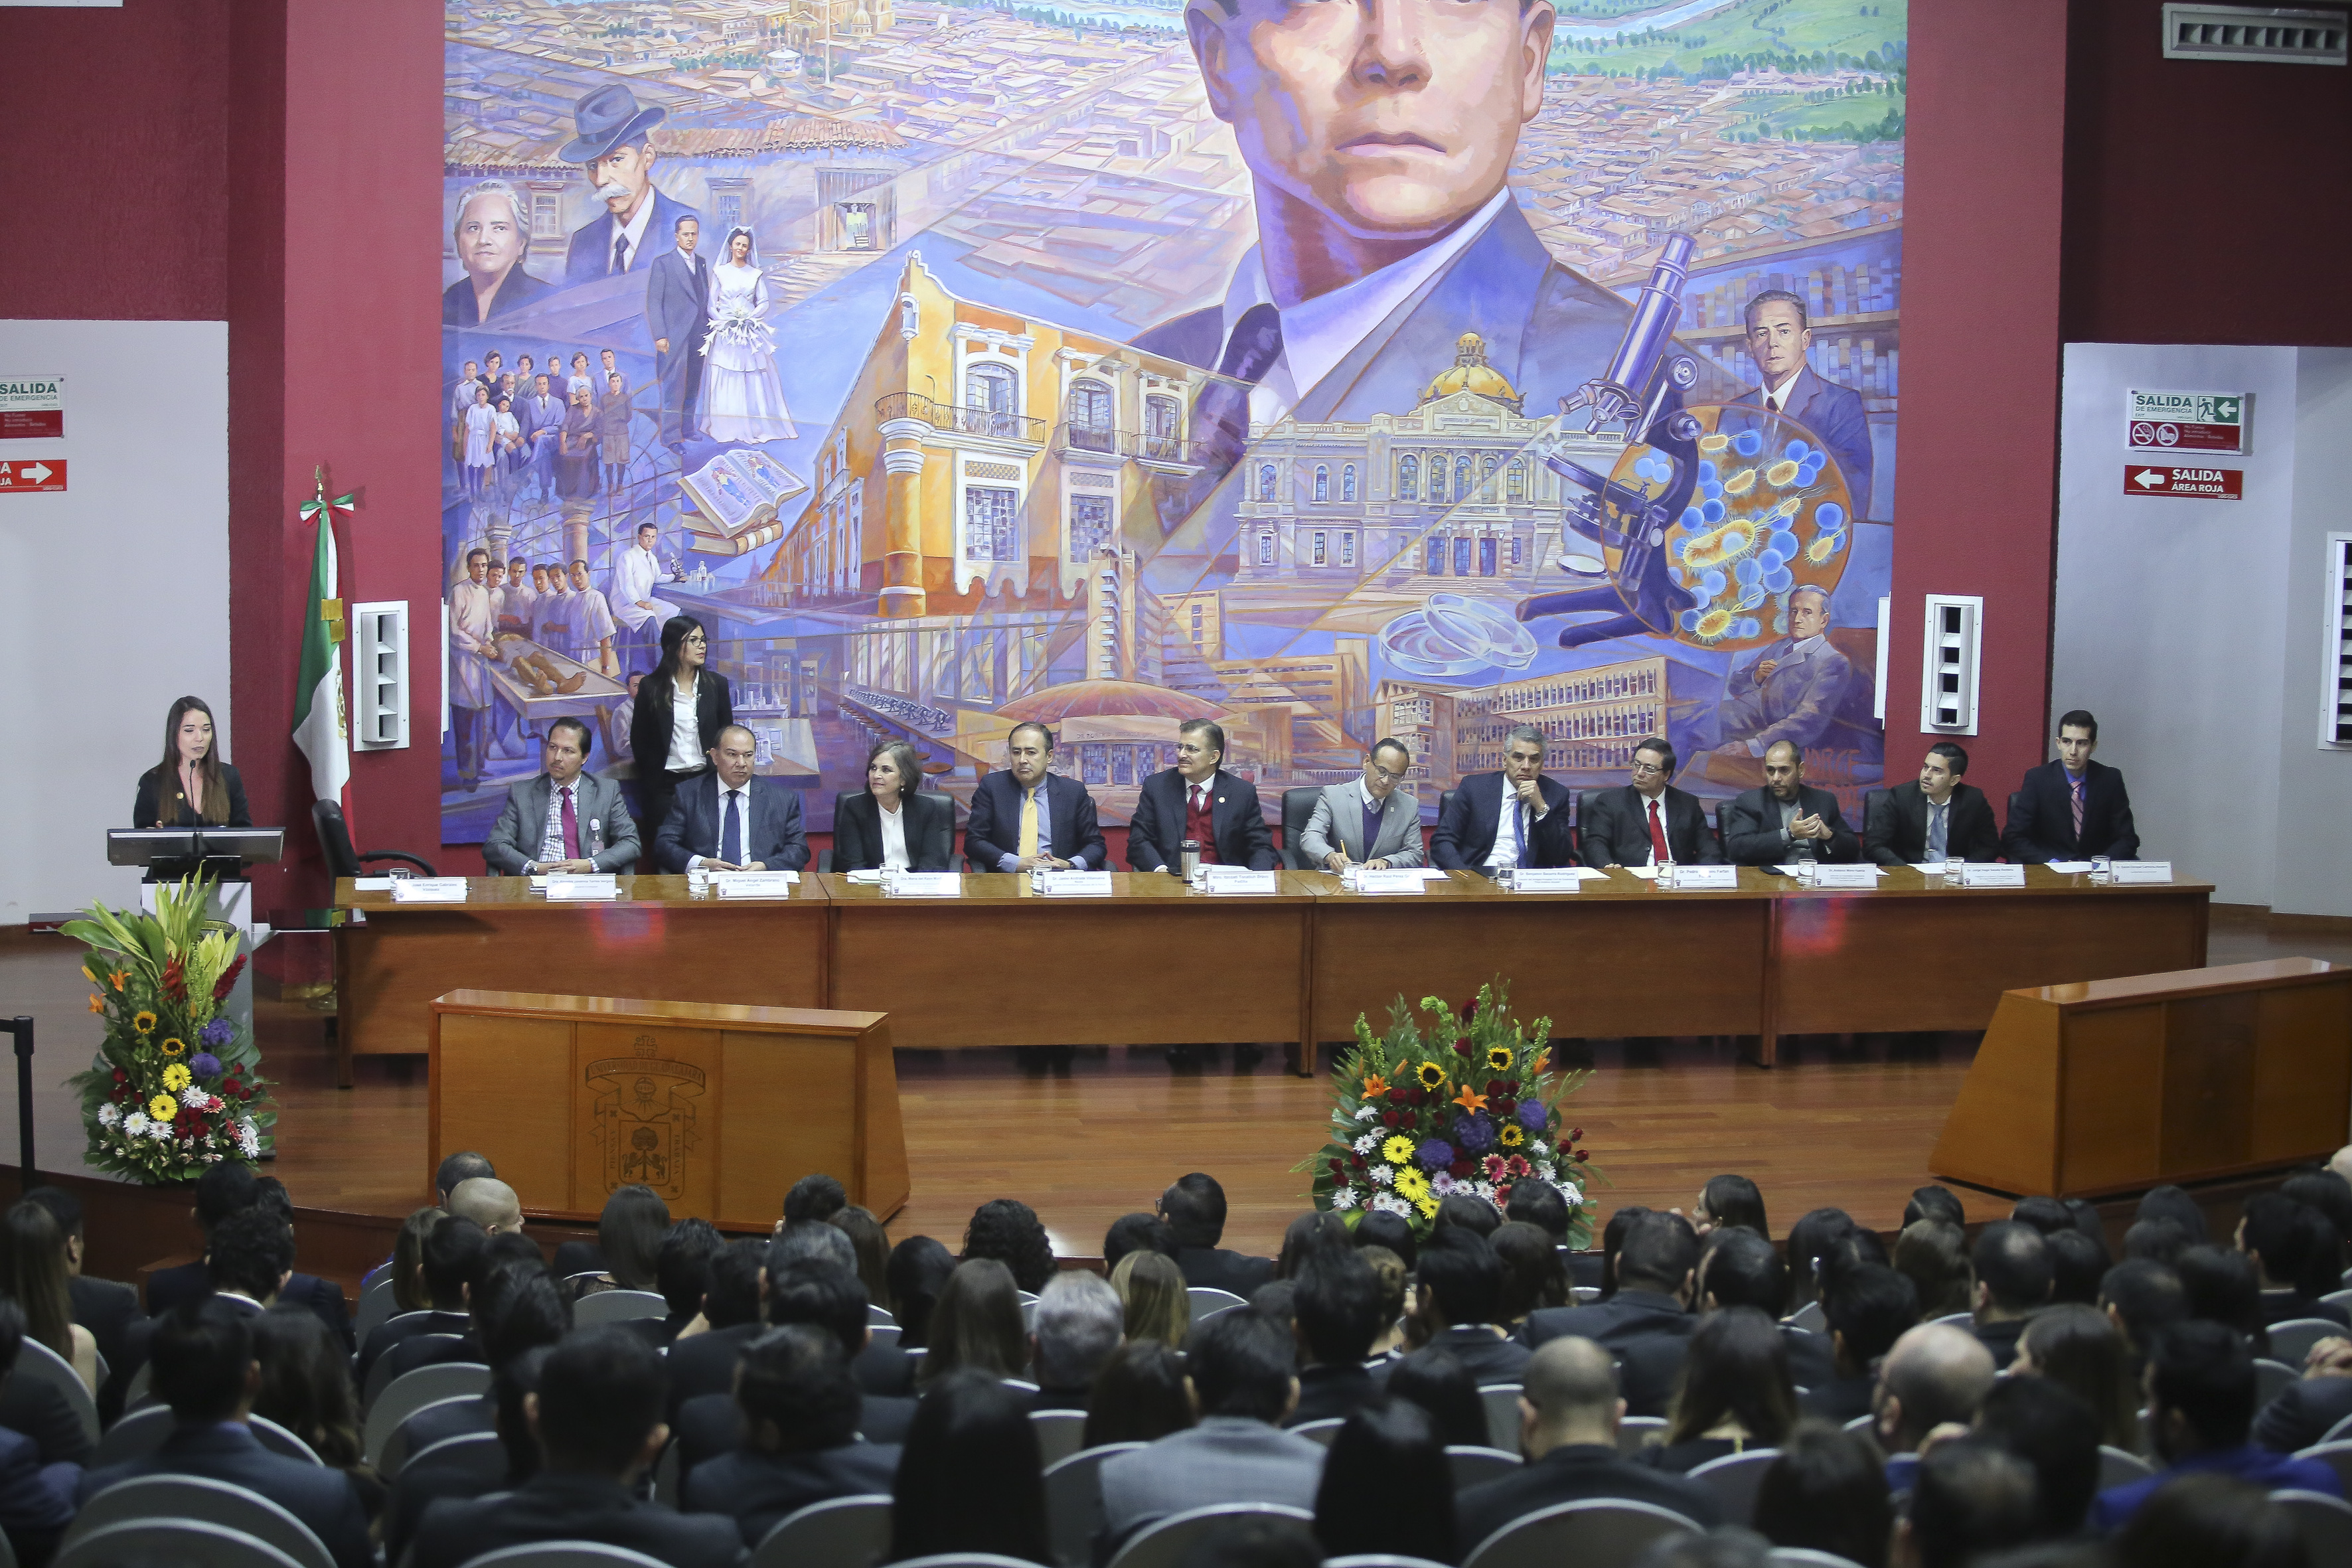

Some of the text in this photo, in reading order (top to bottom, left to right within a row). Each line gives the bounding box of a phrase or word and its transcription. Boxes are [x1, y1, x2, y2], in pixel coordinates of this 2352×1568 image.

[2136, 396, 2192, 407] SALIDA
[2171, 469, 2224, 482] SALIDA
[2171, 481, 2224, 493] ÁREA ROJA
[590, 1060, 702, 1081] UNIVERSIDAD DE GUADALAJARA
